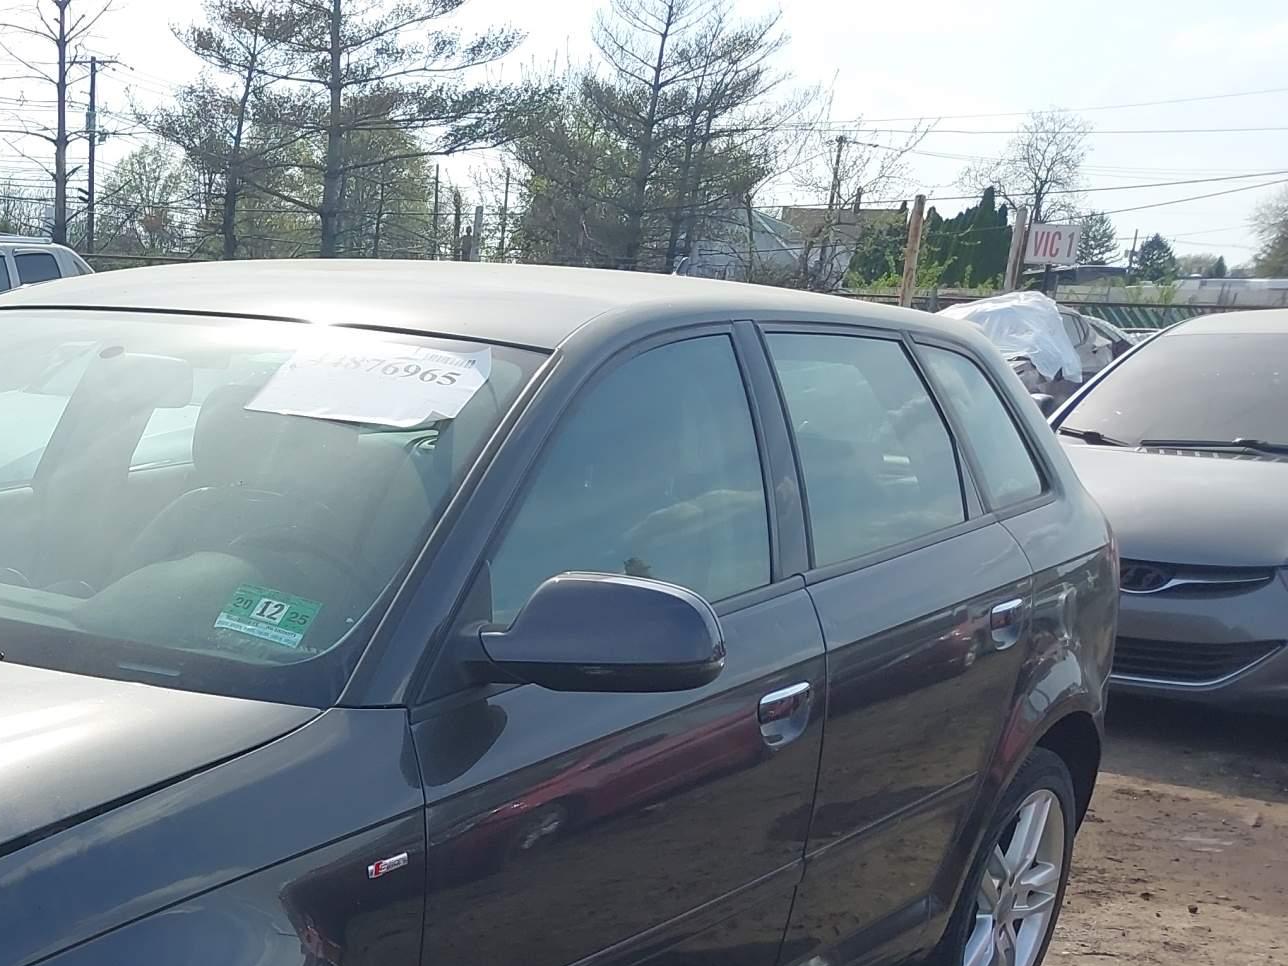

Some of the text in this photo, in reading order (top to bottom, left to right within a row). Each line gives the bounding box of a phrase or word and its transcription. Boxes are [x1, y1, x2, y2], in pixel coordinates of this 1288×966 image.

[1034, 231, 1076, 258] VIC 1
[233, 597, 254, 610] 20
[255, 600, 286, 621] 12
